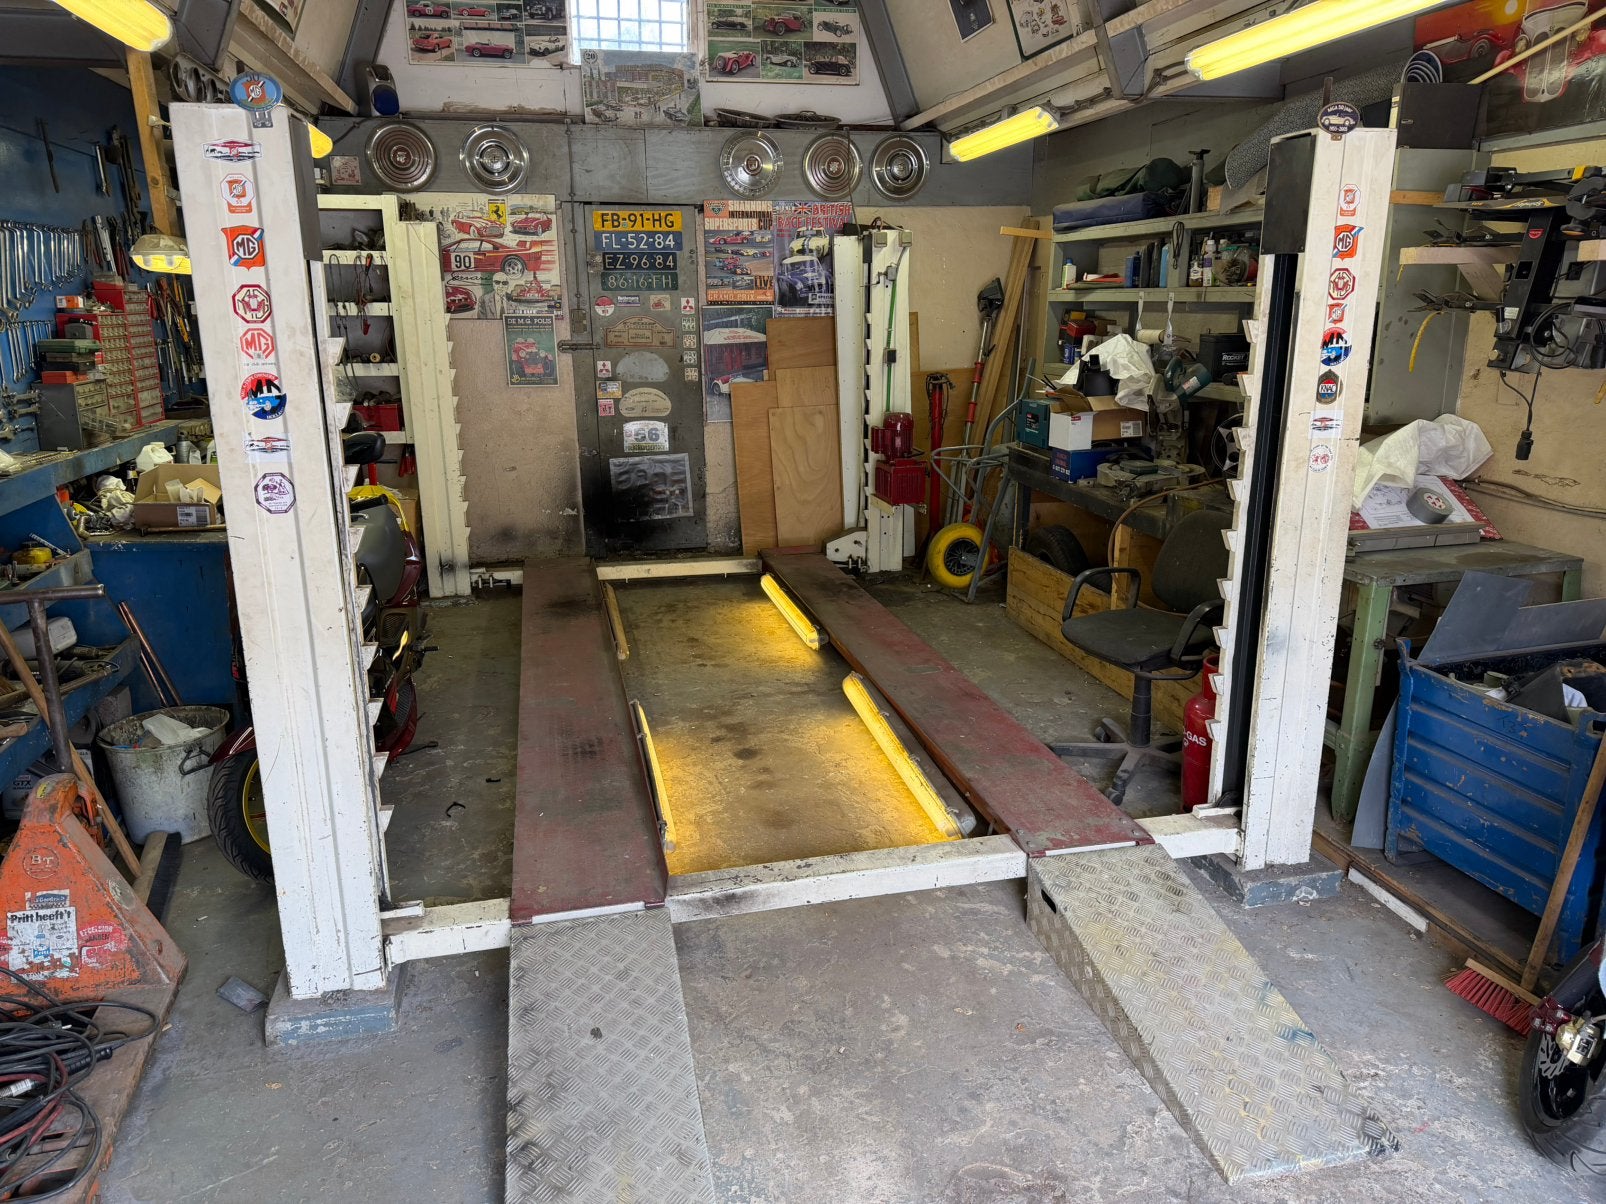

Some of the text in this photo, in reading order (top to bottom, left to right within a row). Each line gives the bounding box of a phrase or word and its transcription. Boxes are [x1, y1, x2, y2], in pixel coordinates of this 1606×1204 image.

[728, 201, 772, 211] SHANNONS
[812, 203, 851, 216] BRITISH
[601, 213, 675, 228] FB-91-HG
[705, 218, 773, 230] SUPERSPORTS CUP
[777, 216, 803, 228] RACE
[235, 236, 257, 257] MG
[601, 233, 675, 249] FL-52-84
[1337, 233, 1352, 250] MG
[454, 254, 472, 269] 90
[708, 293, 756, 301] GRAND PRIX
[244, 331, 271, 354] MG
[1320, 384, 1337, 393] KNAC
[1186, 731, 1208, 747] GAS
[10, 913, 35, 924] Pritt
